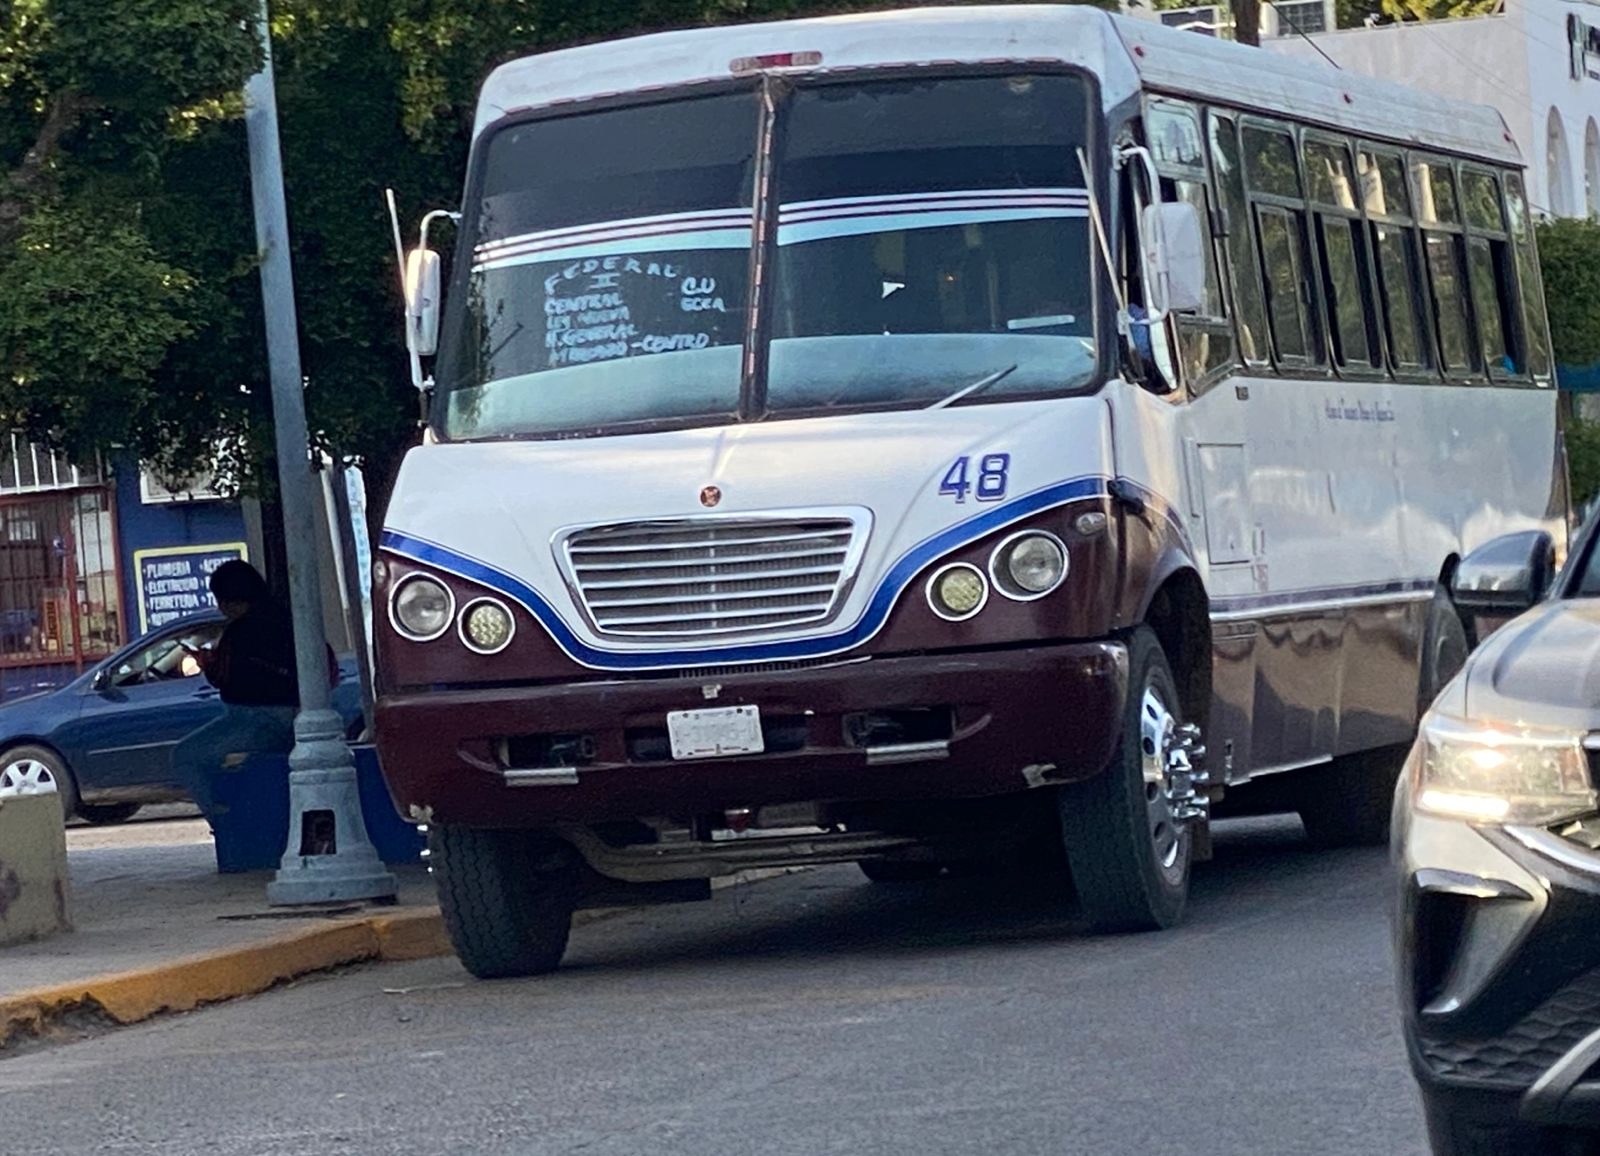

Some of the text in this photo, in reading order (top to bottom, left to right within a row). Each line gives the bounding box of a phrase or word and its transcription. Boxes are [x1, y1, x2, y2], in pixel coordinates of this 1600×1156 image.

[544, 257, 677, 295] FEDERAL
[544, 292, 623, 316] CENTRAL
[939, 453, 1010, 504] 48
